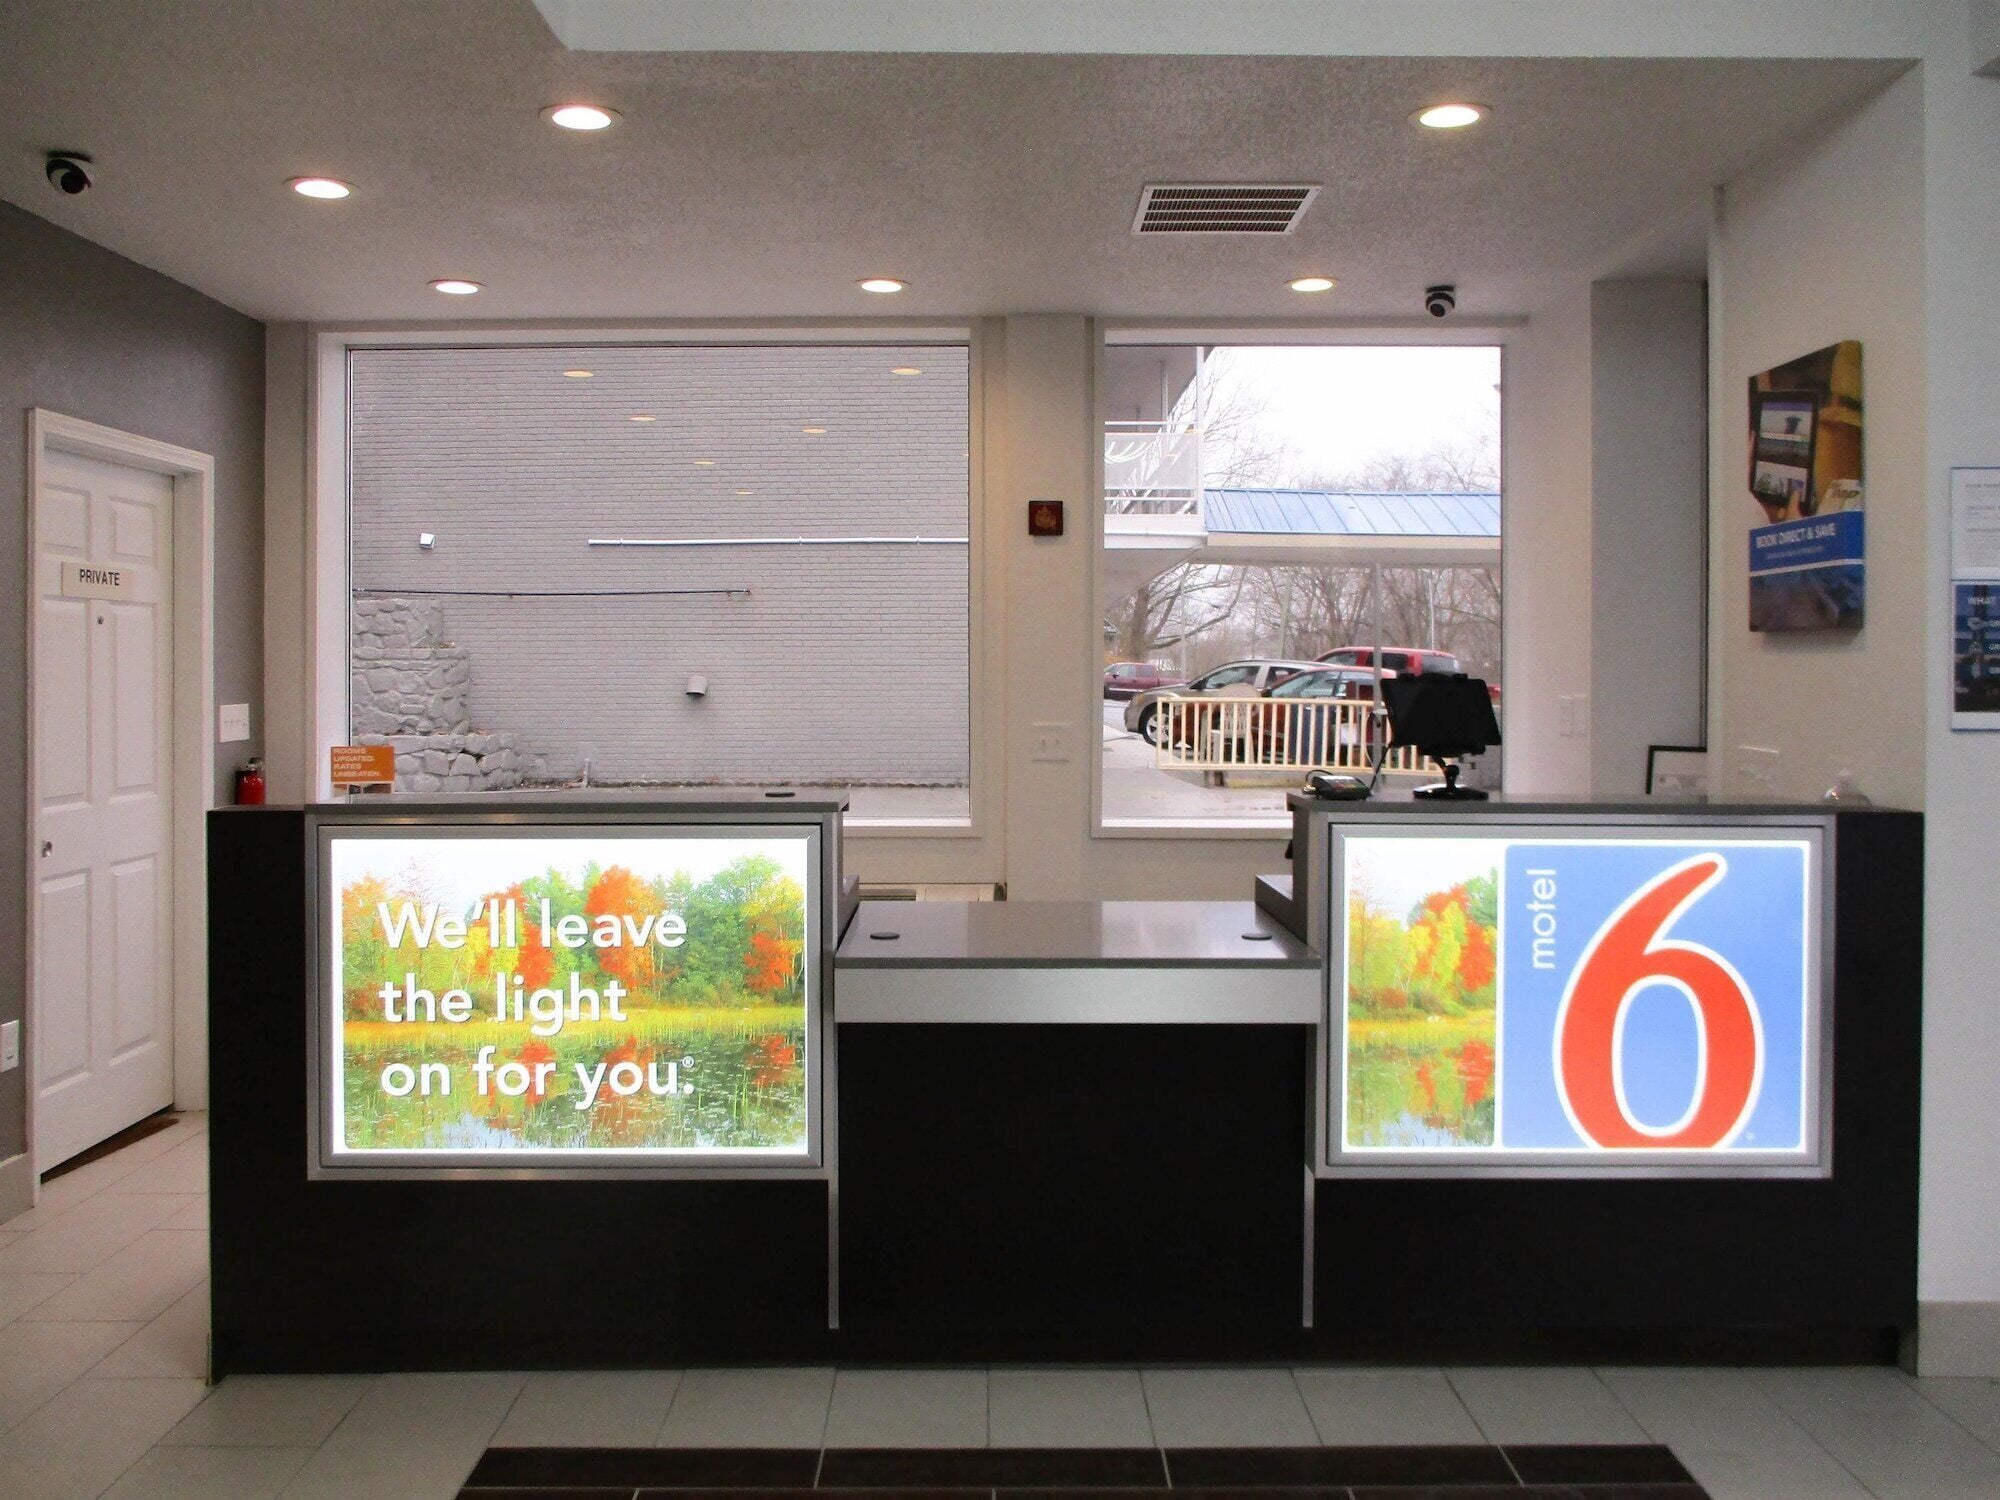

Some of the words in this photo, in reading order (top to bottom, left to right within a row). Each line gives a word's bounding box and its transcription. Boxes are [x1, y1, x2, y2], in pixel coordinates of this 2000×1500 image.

[1756, 534, 1778, 549] BOOK
[1778, 528, 1806, 545] DIRECT
[1815, 523, 1836, 538] SAVE
[79, 568, 121, 586] PRIVATE
[377, 897, 518, 950] We'll
[540, 897, 688, 950] leave
[379, 972, 474, 1024] the
[496, 971, 628, 1037] light
[1526, 868, 1557, 970] motel
[1552, 852, 1766, 1148] 6
[380, 1061, 452, 1097] on
[473, 1045, 558, 1097] for
